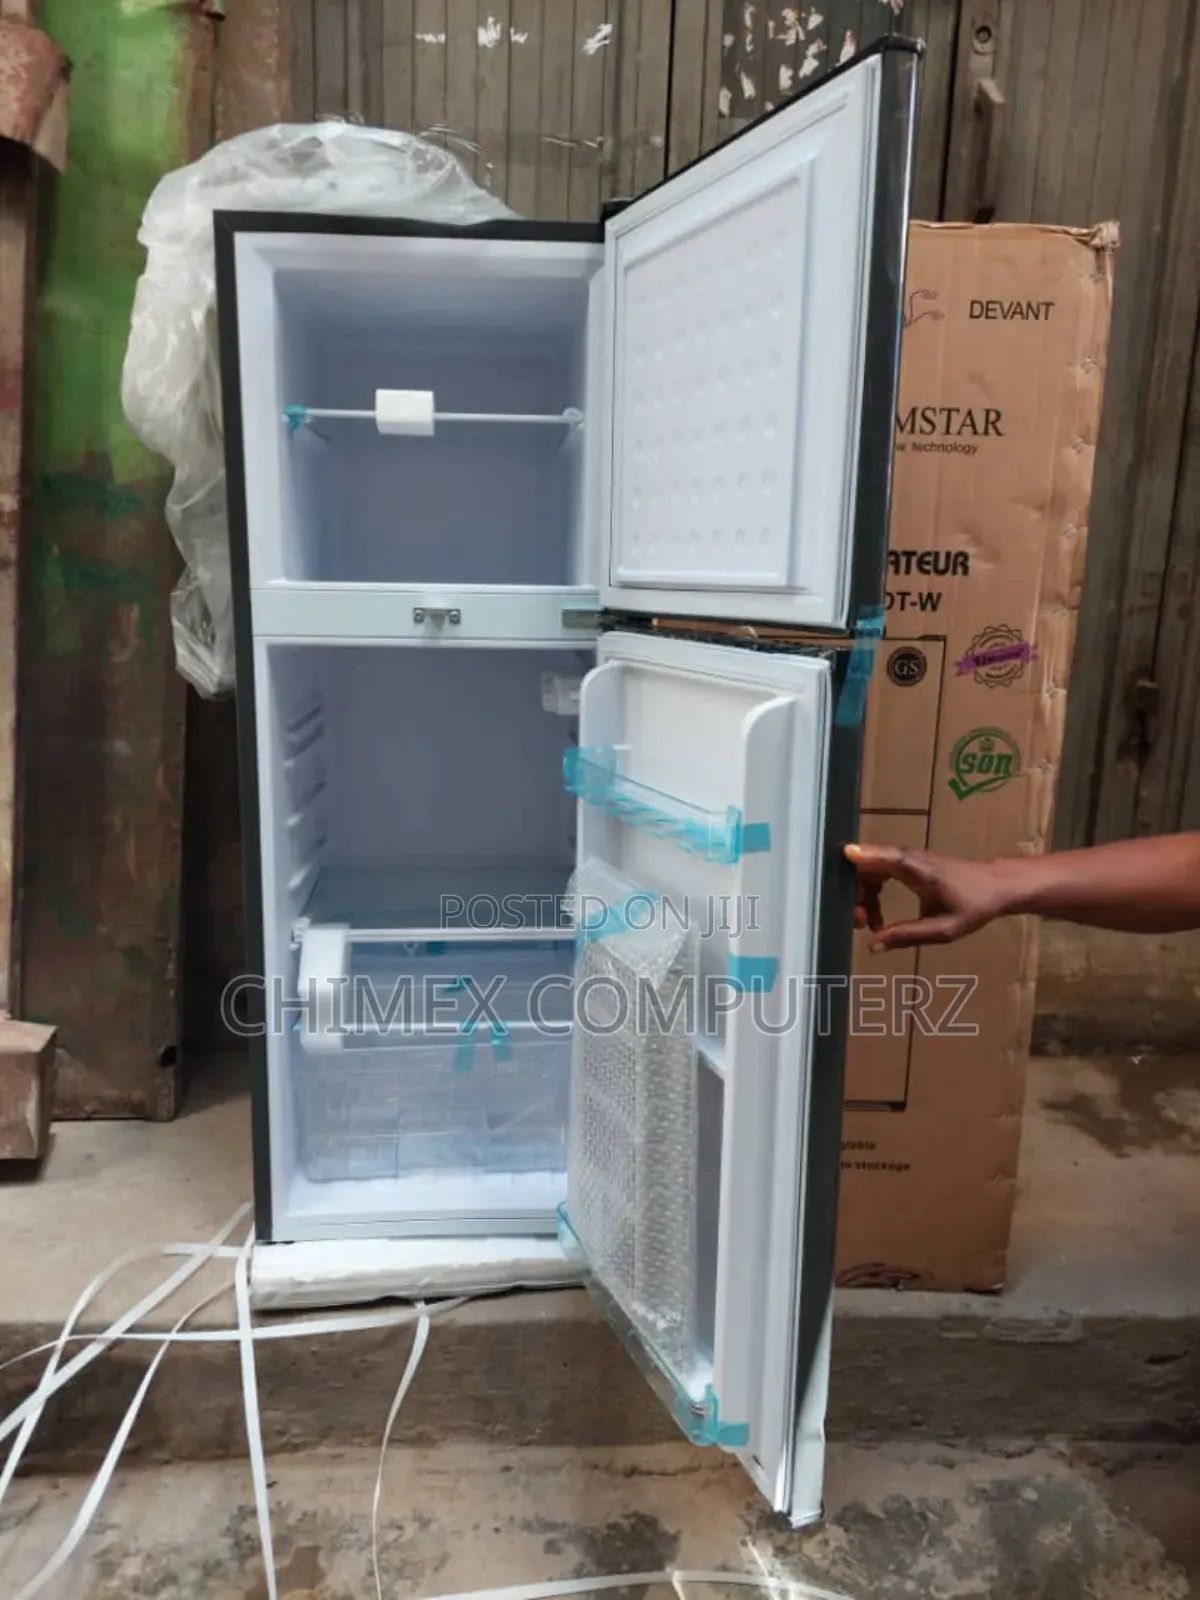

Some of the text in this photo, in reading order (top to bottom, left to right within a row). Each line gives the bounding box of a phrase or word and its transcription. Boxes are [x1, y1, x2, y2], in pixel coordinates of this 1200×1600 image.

[968, 300, 1056, 320] DEVANT
[912, 441, 979, 456] technology
[888, 550, 970, 576] ATEUR
[895, 661, 918, 675] GS
